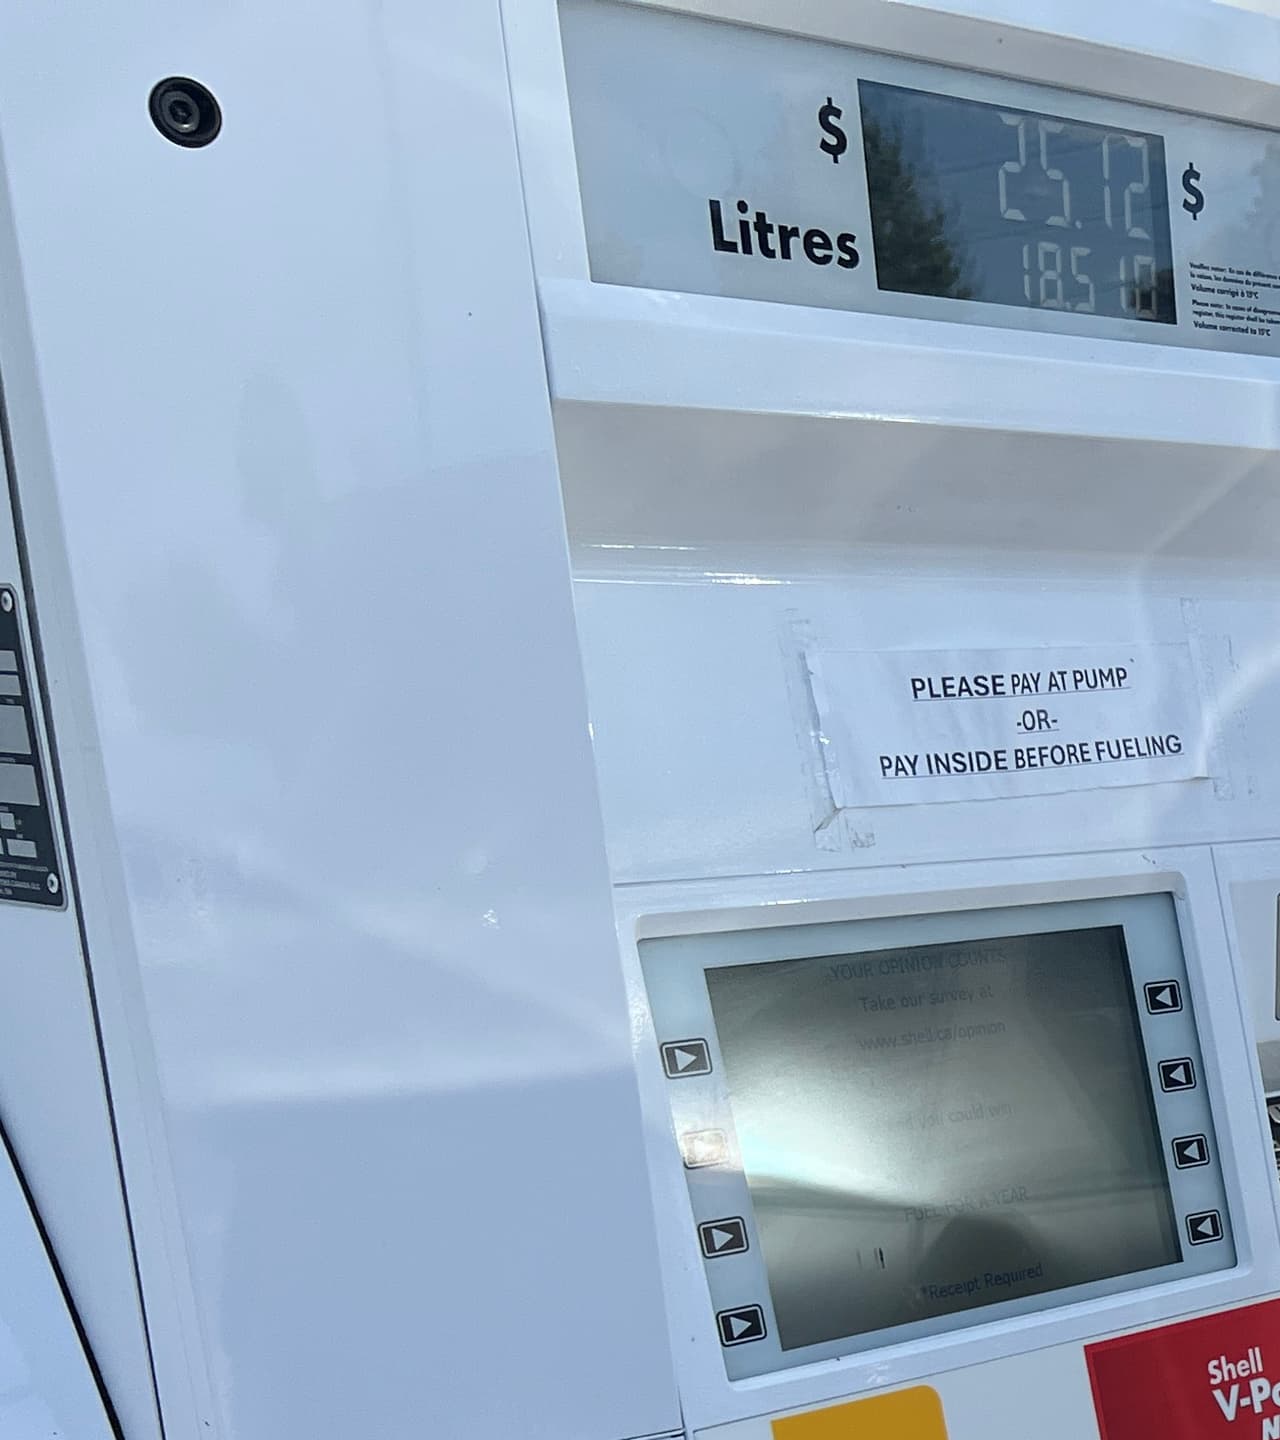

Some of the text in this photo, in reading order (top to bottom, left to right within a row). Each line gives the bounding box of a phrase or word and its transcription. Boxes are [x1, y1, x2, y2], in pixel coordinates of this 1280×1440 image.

[818, 97, 1205, 240] $ 25.12 $
[708, 199, 860, 269] Litres
[910, 666, 1128, 699] PLEASE PAY AT PUMP
[1016, 708, 1058, 732] -OR-
[879, 733, 1183, 777] PAY INSIDE BEFORE FUELING
[829, 963, 873, 981] YOUR
[879, 953, 943, 976] OPINION
[860, 985, 993, 1013] Take our survey at
[902, 1204, 942, 1223] FUEL
[990, 1186, 1030, 1206] YEAR
[984, 1263, 1044, 1289] Required
[1208, 1346, 1263, 1385] Shell
